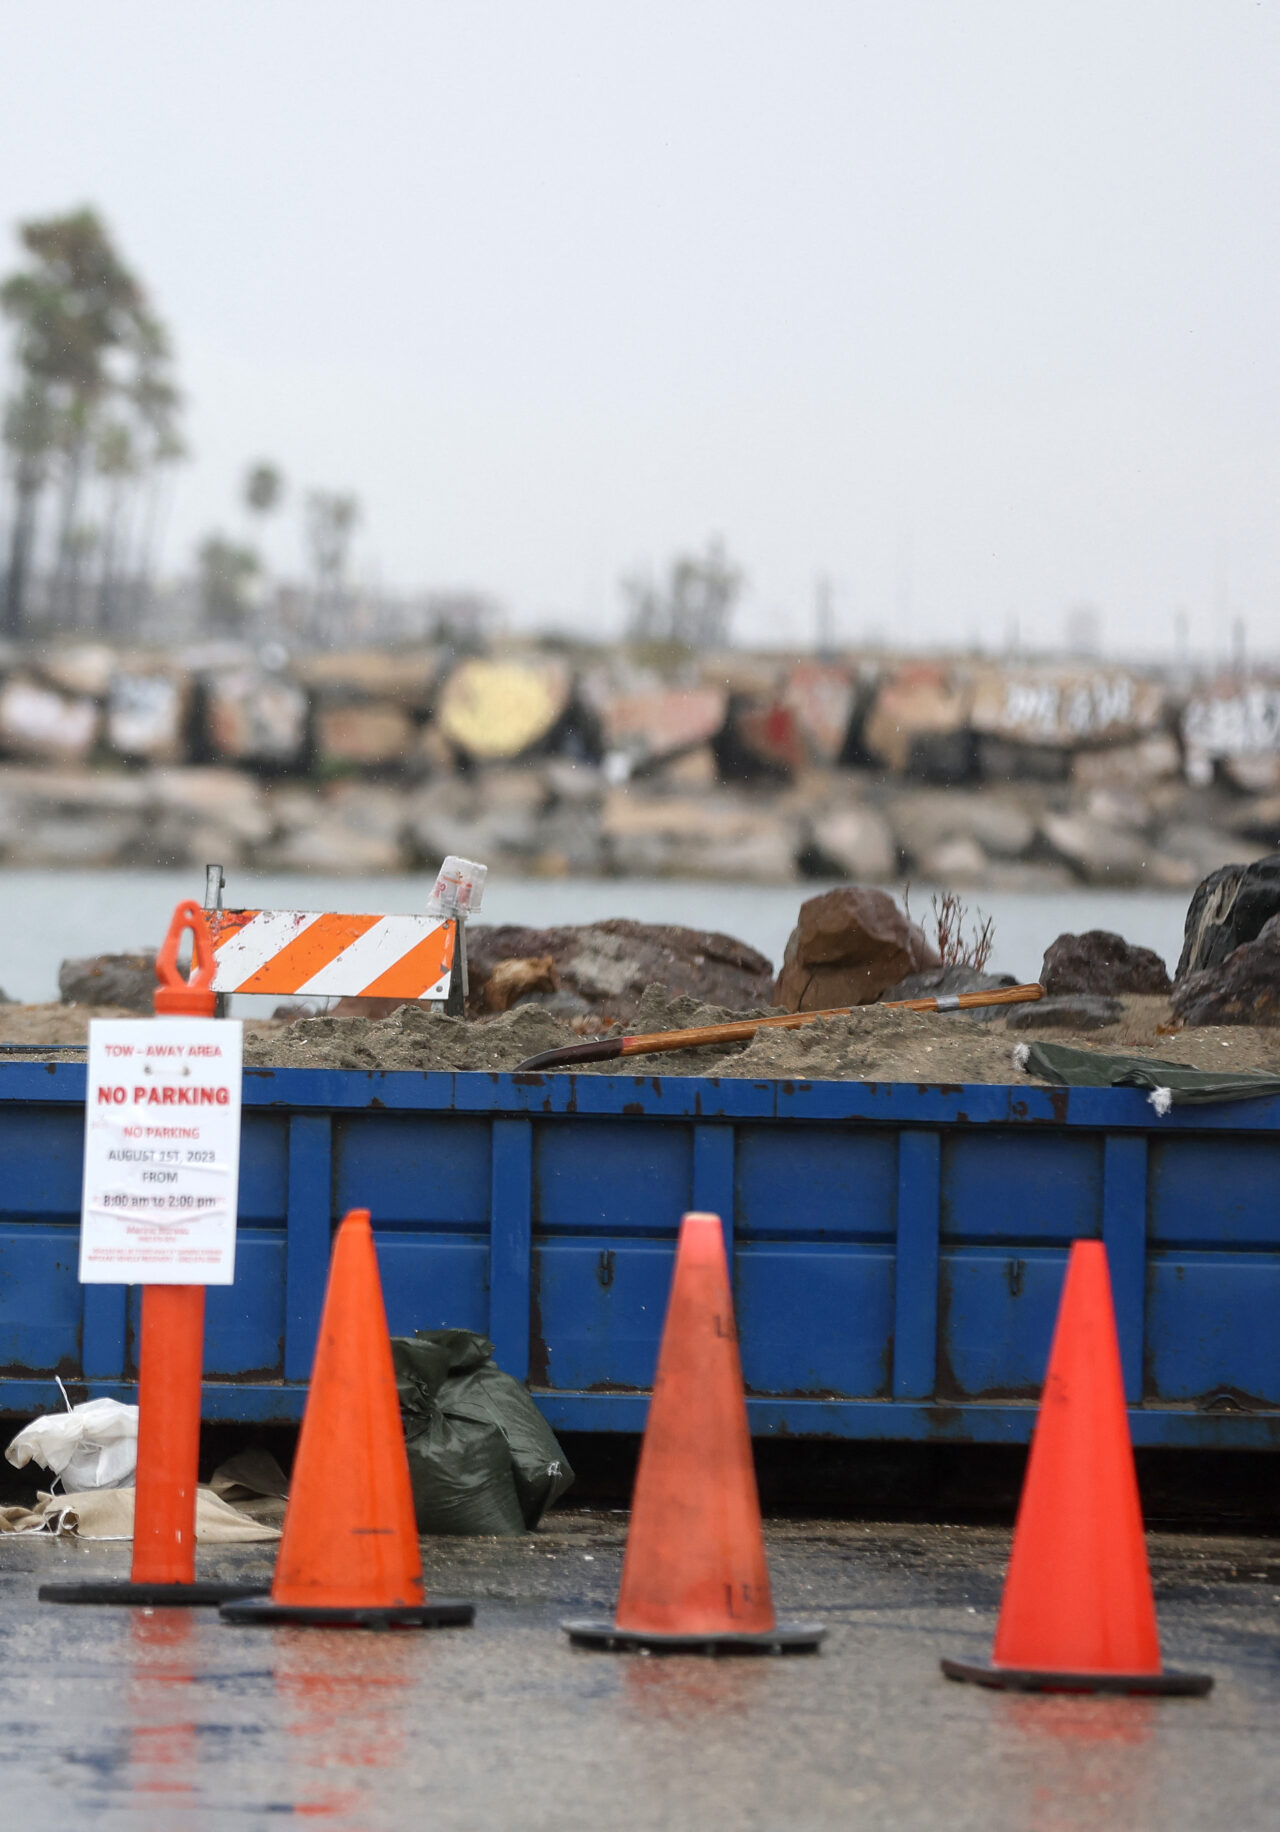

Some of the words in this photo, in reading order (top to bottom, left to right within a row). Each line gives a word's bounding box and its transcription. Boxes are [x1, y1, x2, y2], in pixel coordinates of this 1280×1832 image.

[105, 1045, 134, 1057] TOW
[146, 1046, 185, 1057] AWAY
[188, 1046, 222, 1057] AREA
[98, 1086, 127, 1105] NO
[133, 1086, 230, 1106] PARKING
[123, 1127, 143, 1138] NO
[146, 1127, 200, 1139] PARKING
[108, 1150, 155, 1162] AUGUST
[186, 1151, 216, 1163] 2023
[142, 1172, 178, 1183] FROM
[104, 1195, 129, 1207] 8:00
[131, 1197, 150, 1207] am
[152, 1195, 166, 1207] to
[168, 1196, 194, 1208] 2:00
[197, 1198, 216, 1209] pm
